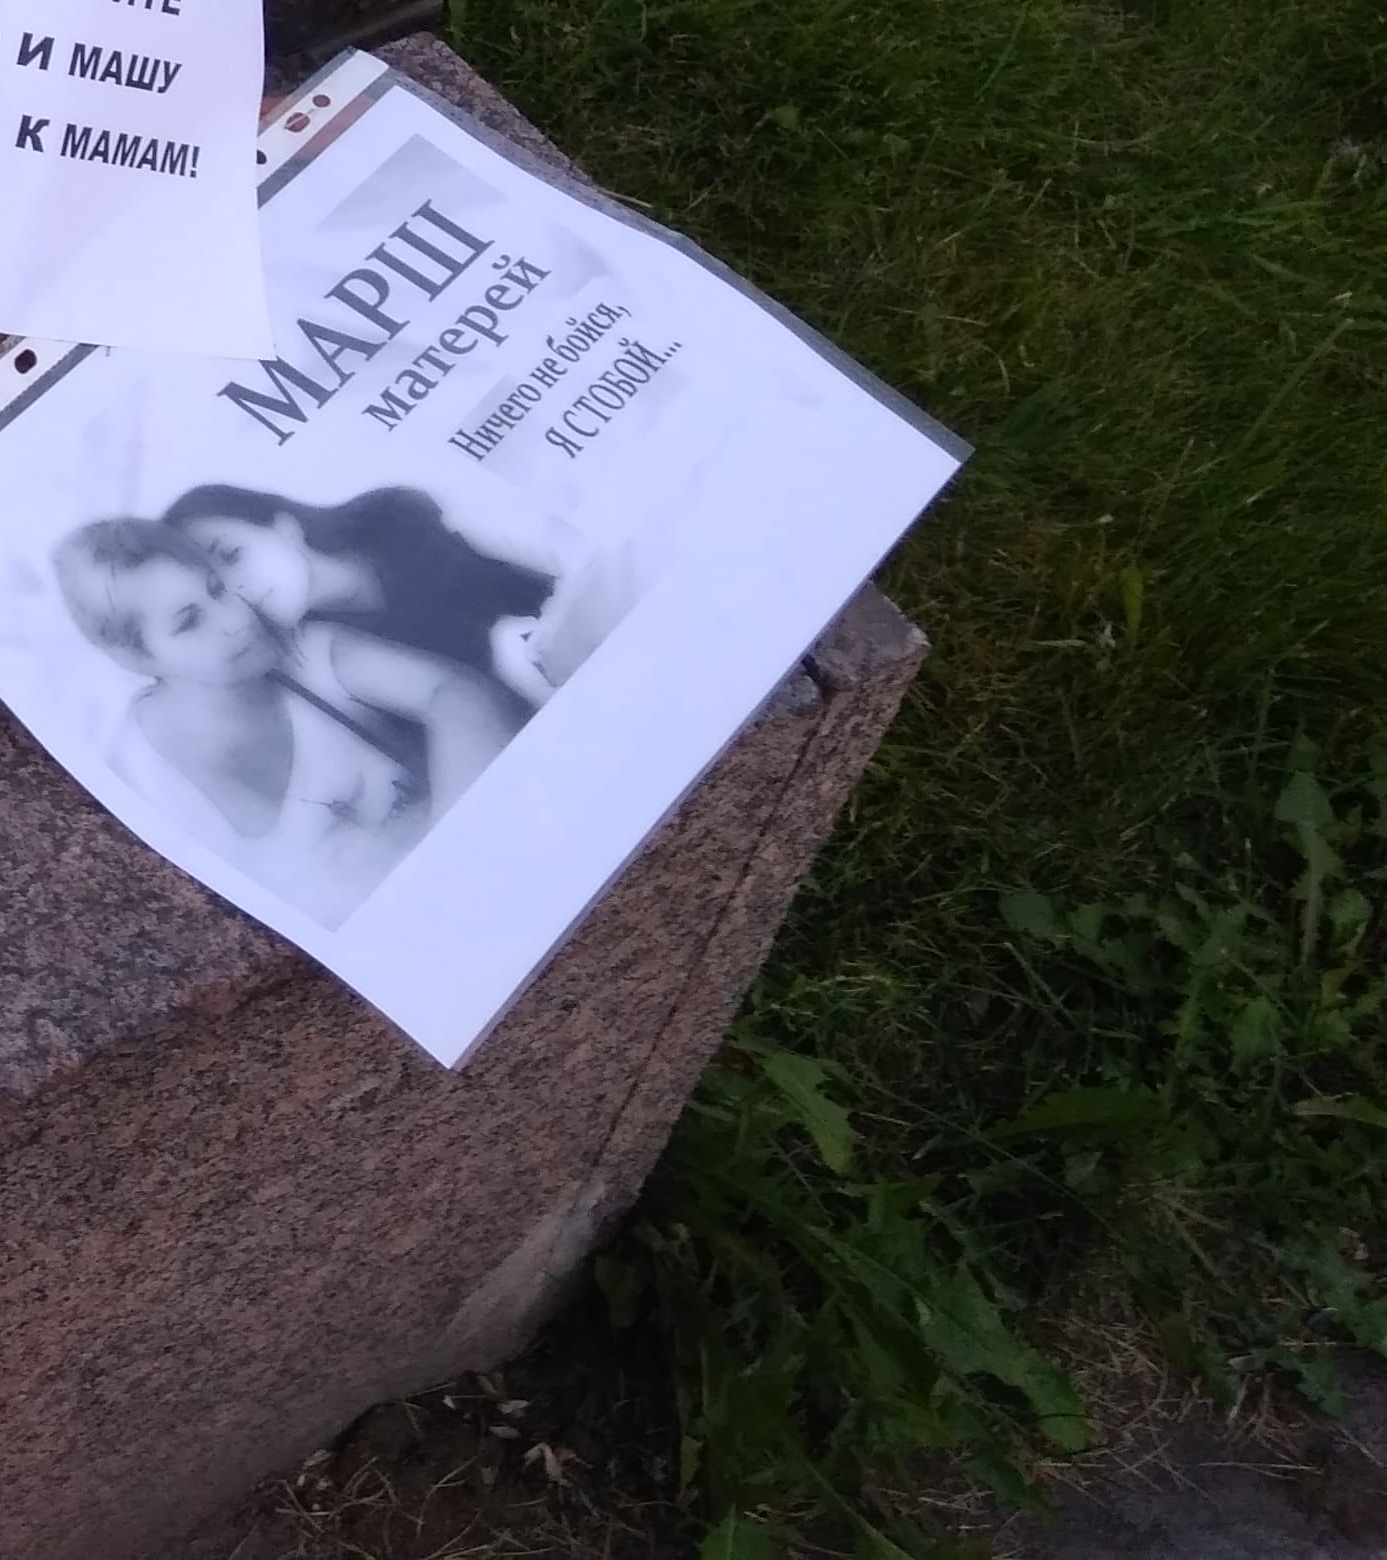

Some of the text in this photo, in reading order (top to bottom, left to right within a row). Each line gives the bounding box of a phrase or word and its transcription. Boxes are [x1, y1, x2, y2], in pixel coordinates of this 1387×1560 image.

[16, 32, 55, 70] И
[68, 43, 182, 93] МАШУ
[15, 115, 50, 152] К
[60, 123, 200, 178] МАМАМ!
[217, 199, 494, 446] МАРШ
[362, 255, 551, 431] матерей
[448, 302, 632, 461] Ничего не бойся,
[545, 427, 584, 458] Я
